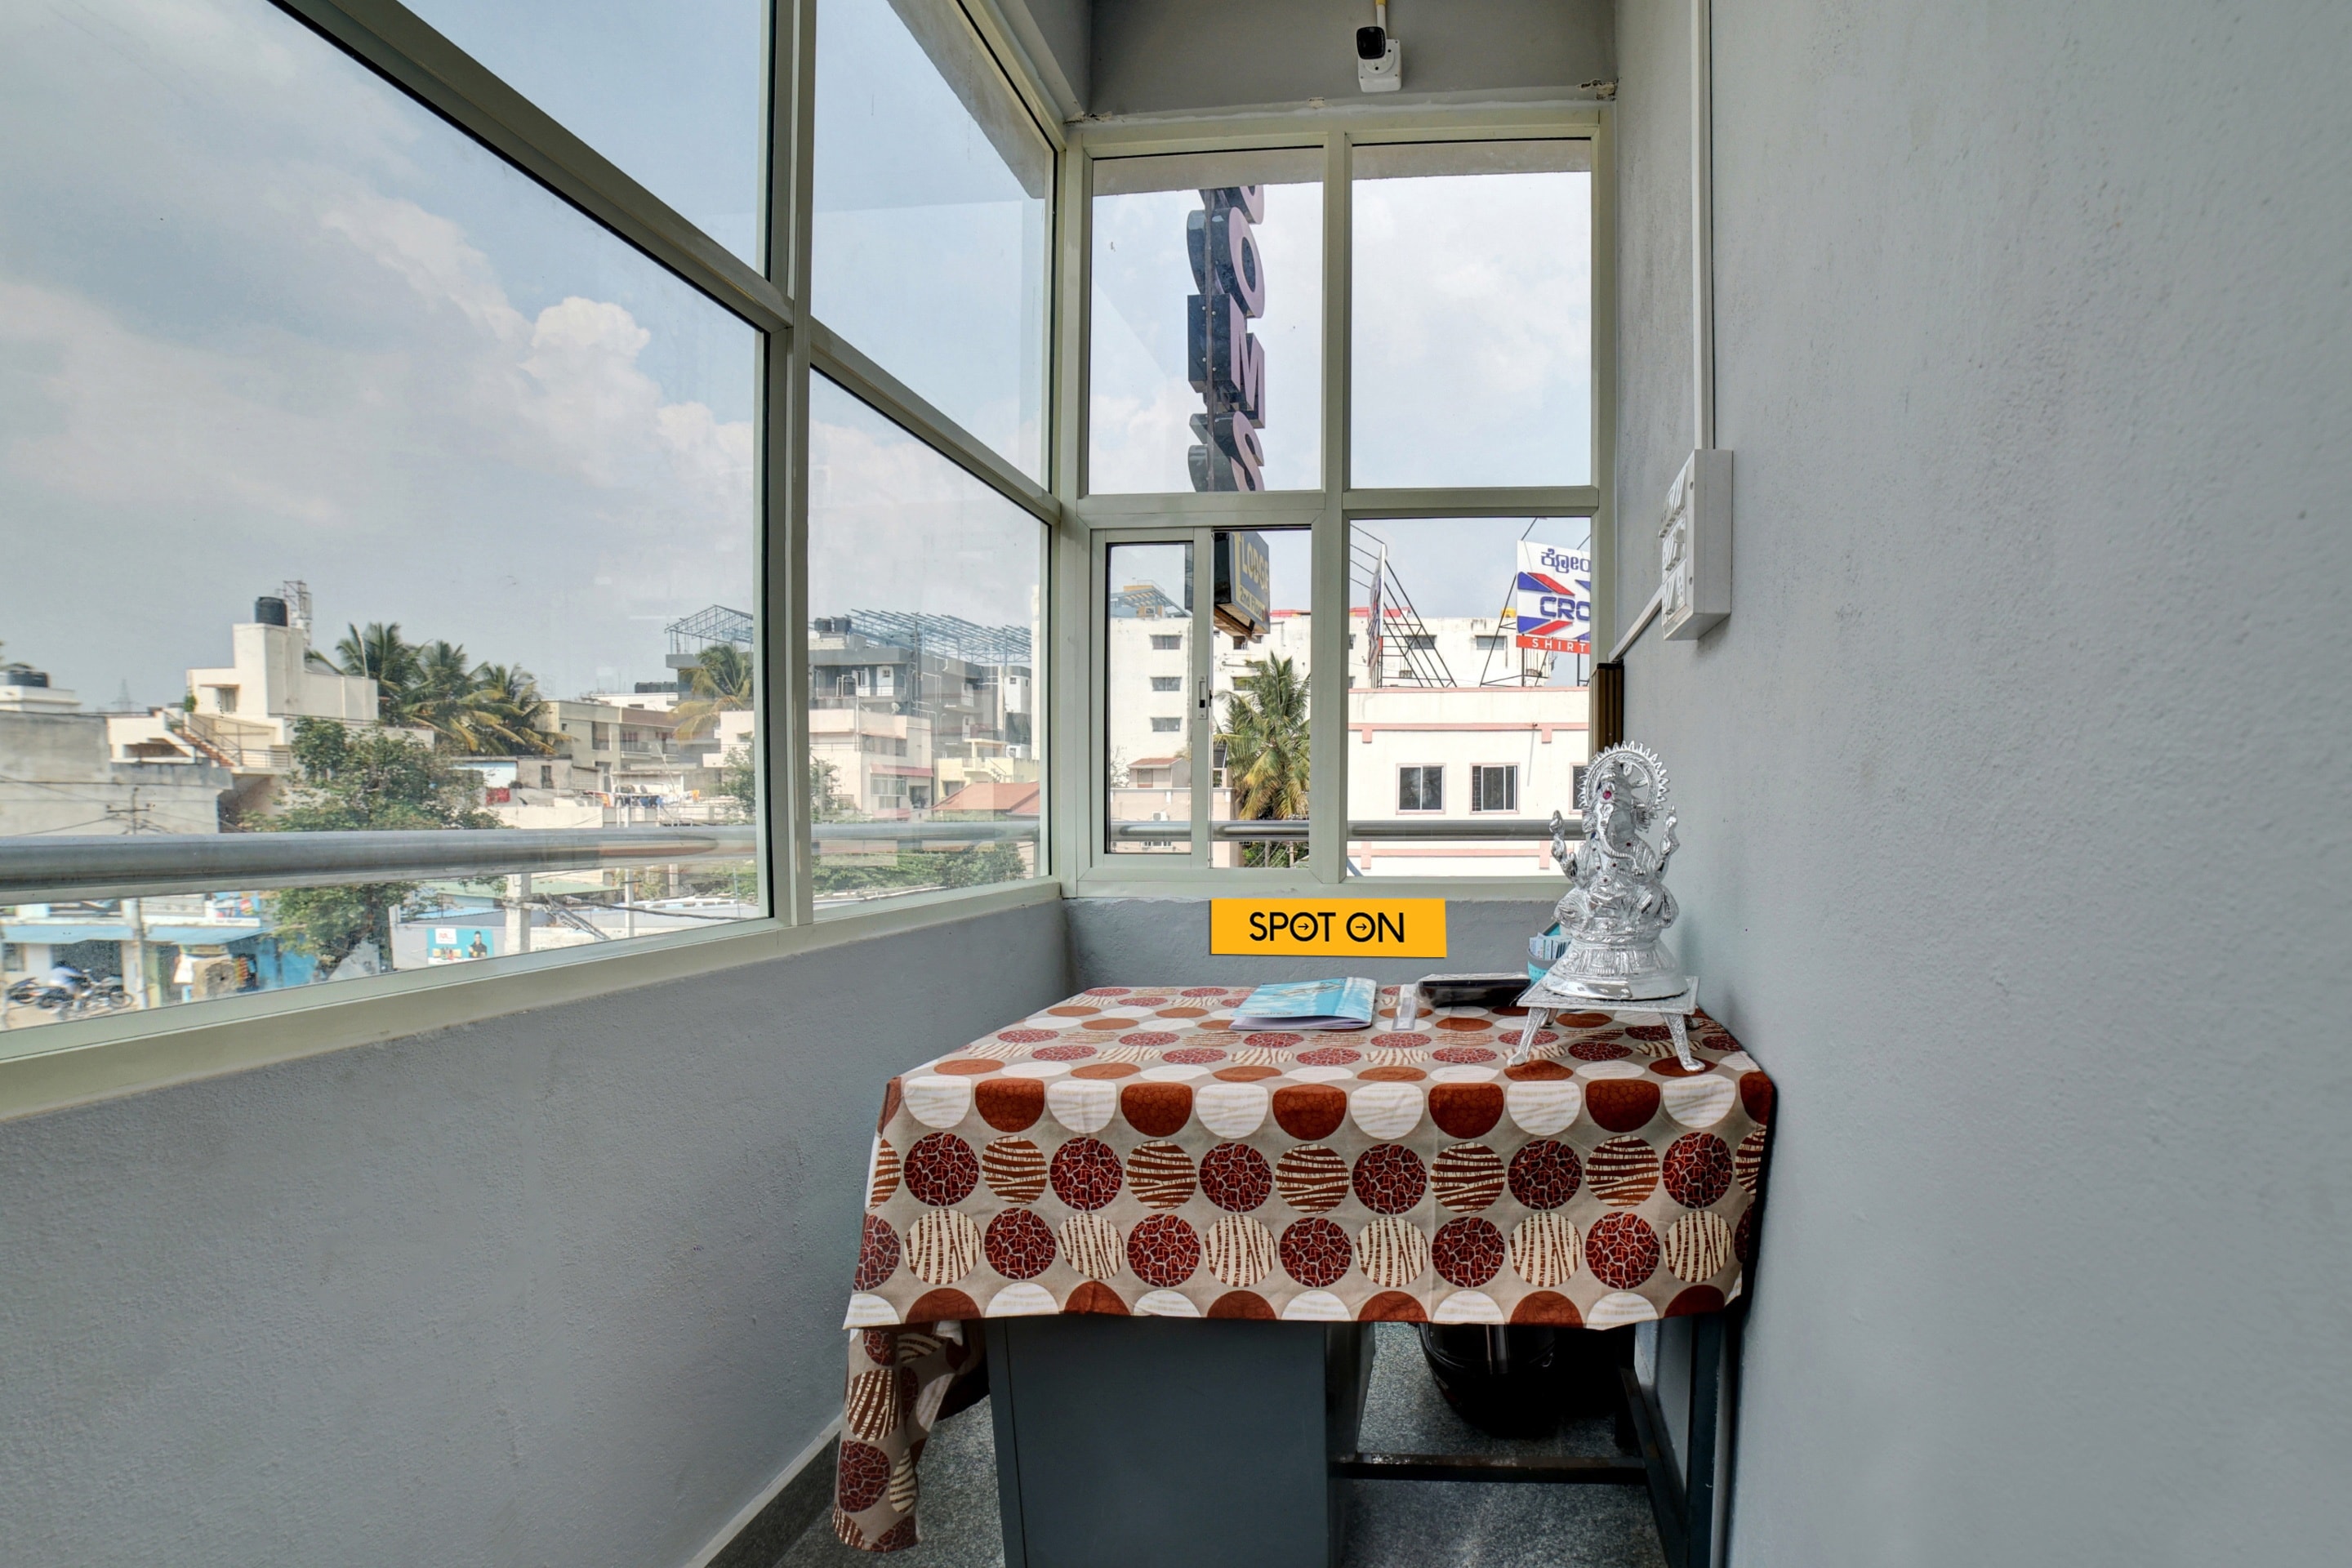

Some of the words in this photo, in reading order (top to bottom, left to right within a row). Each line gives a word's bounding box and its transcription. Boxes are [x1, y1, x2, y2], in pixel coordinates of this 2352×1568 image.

[1241, 536, 1268, 590] LODGE
[1240, 587, 1250, 608] 2nd
[1532, 638, 1586, 653] SHIRT
[1250, 911, 1336, 942] SPOT
[1346, 912, 1405, 942] ON
